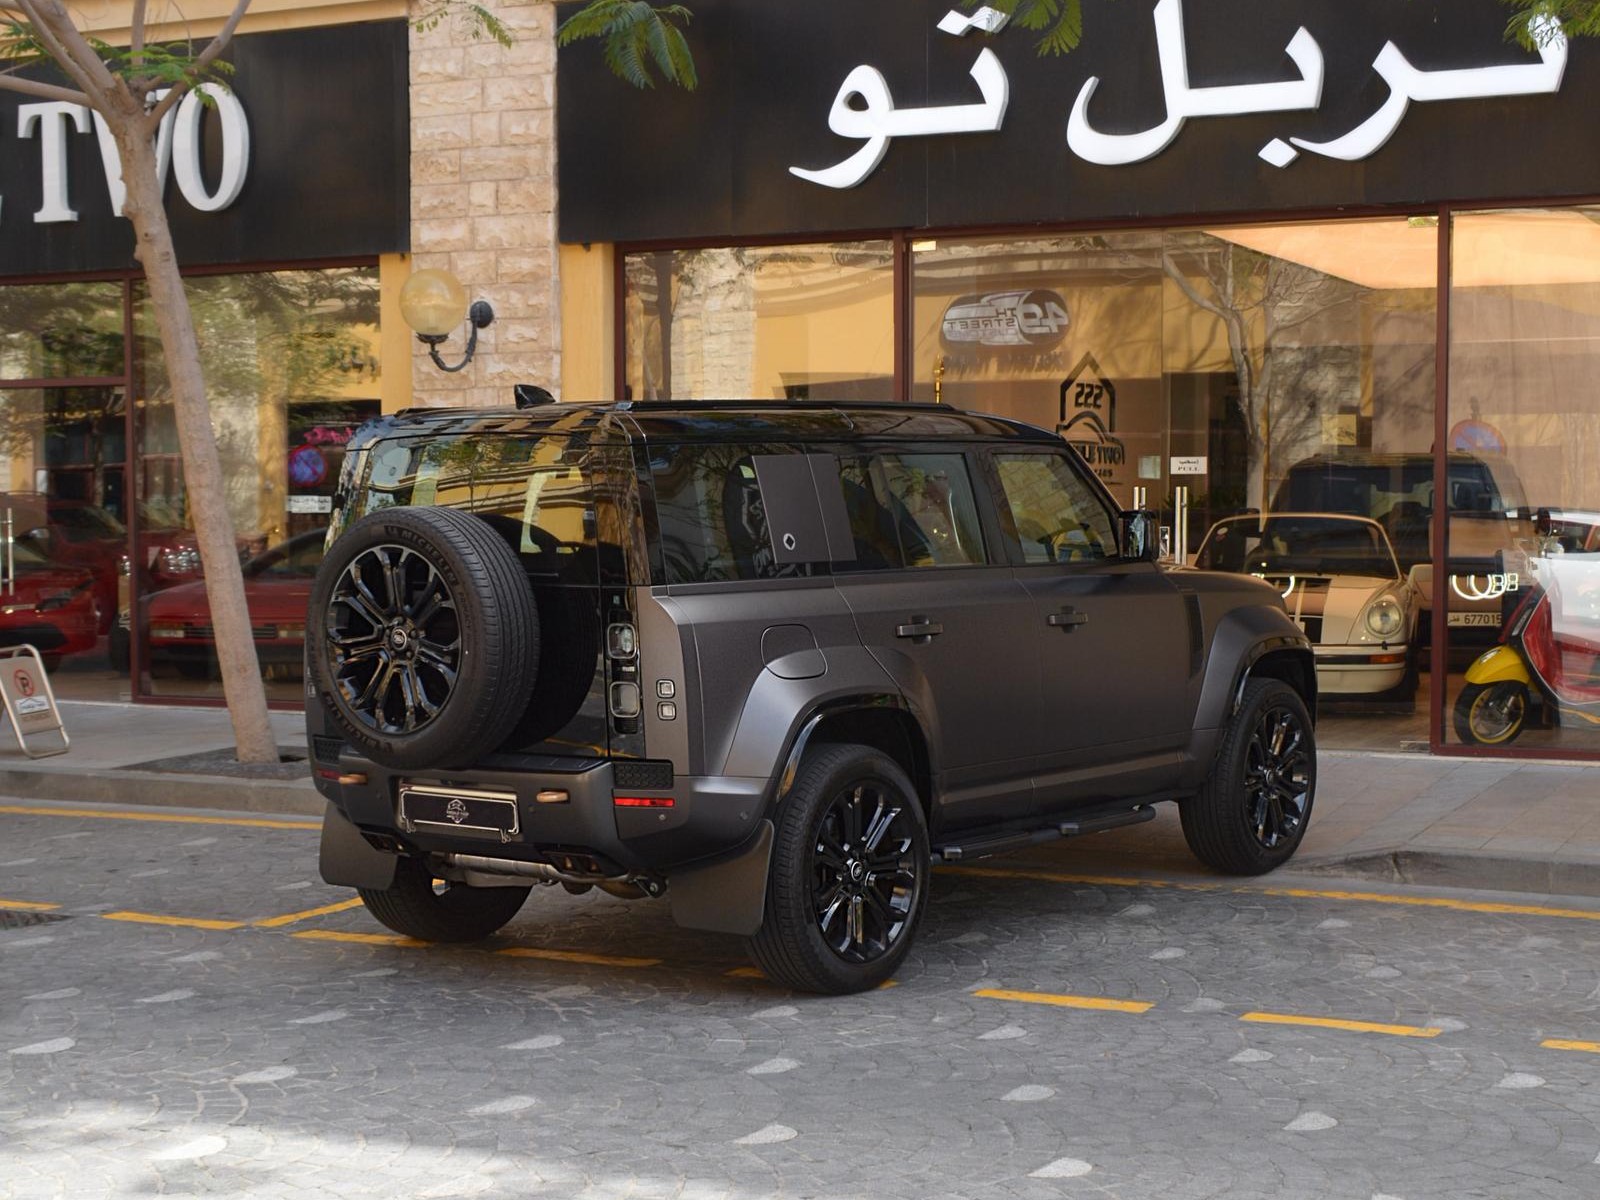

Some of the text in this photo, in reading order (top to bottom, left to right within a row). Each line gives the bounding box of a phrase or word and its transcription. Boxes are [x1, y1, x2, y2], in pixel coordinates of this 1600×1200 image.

[1074, 382, 1104, 409] 222
[401, 528, 457, 586] MICHELIN
[1464, 614, 1502, 625] 677015
